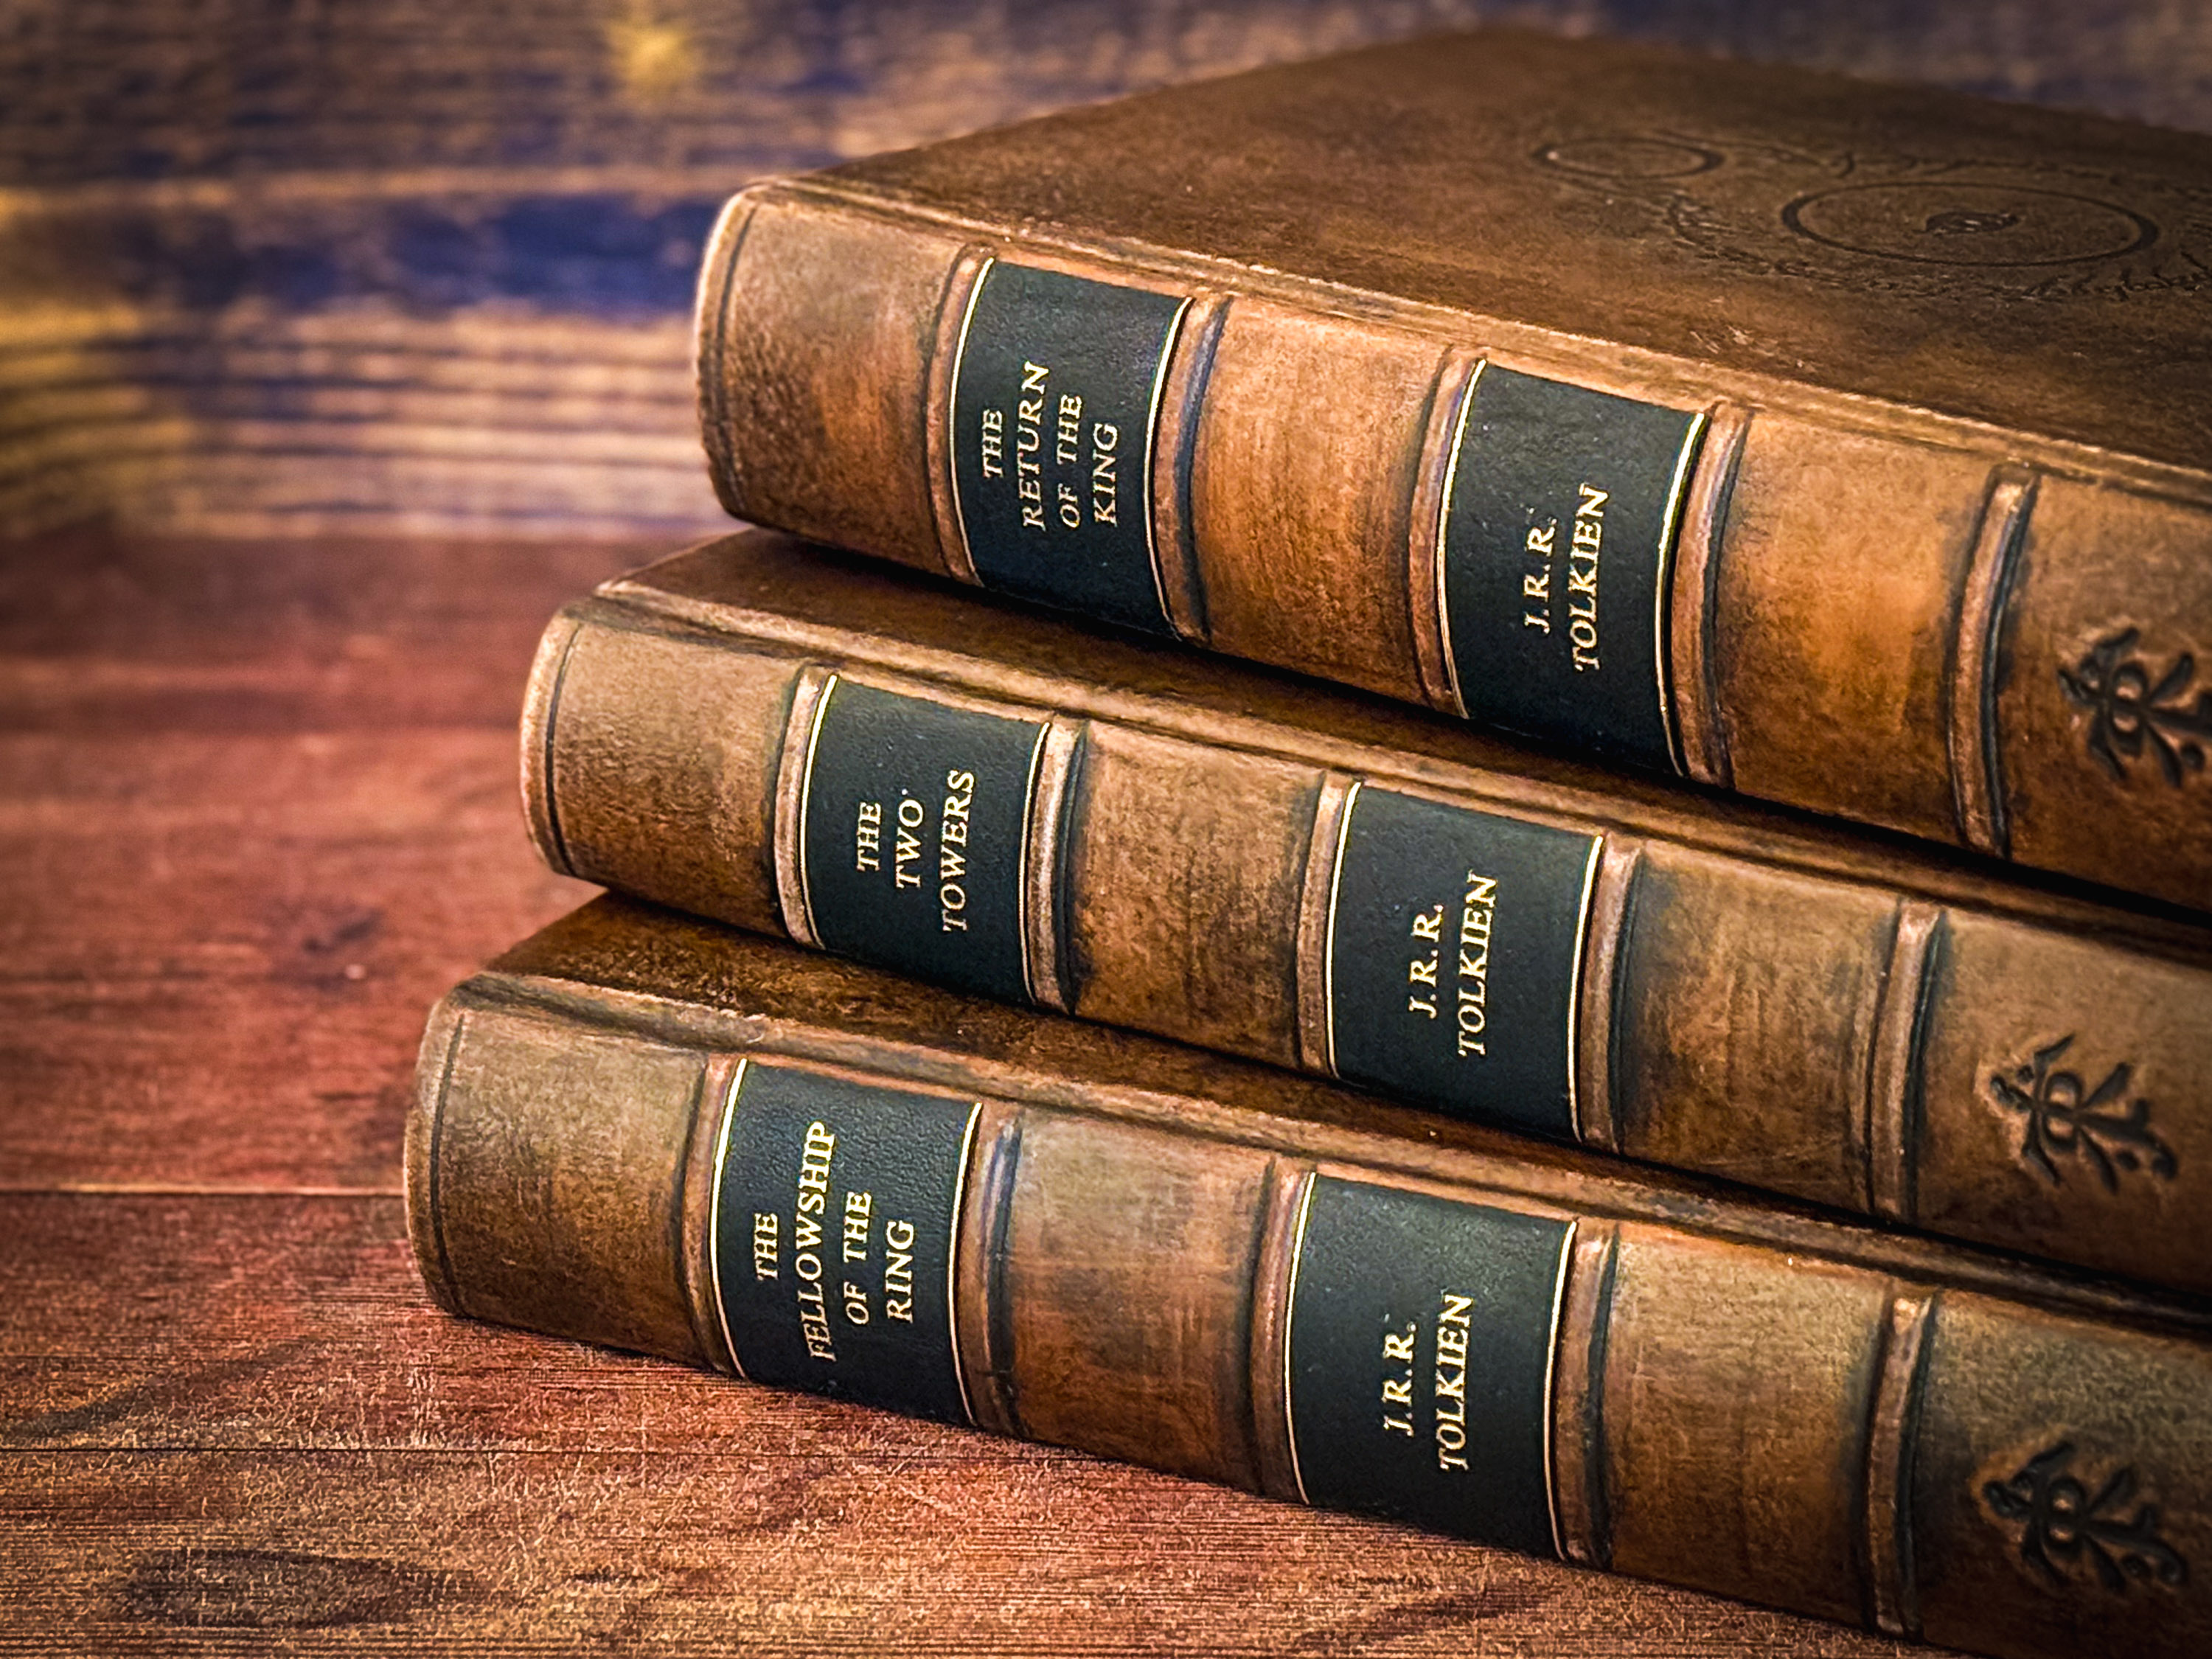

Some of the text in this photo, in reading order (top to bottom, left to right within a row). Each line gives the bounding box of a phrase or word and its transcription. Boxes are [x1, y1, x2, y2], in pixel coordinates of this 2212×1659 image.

[981, 408, 1004, 478] THE
[1017, 360, 1049, 532] RETURN
[1057, 394, 1082, 529] OF THE
[1093, 422, 1118, 527] KING
[1568, 482, 1610, 672] TOLKIEN
[856, 801, 881, 872] THE
[895, 798, 923, 889] TWO
[940, 769, 975, 932] TOWERS
[1458, 869, 1498, 1057] TOLKIEN
[754, 1211, 779, 1281] THE
[796, 1120, 837, 1363] FELLOWSHIP
[843, 1191, 872, 1326] OF THE
[886, 1220, 915, 1324] RING
[1436, 1288, 1474, 1472] TOLKIEN
